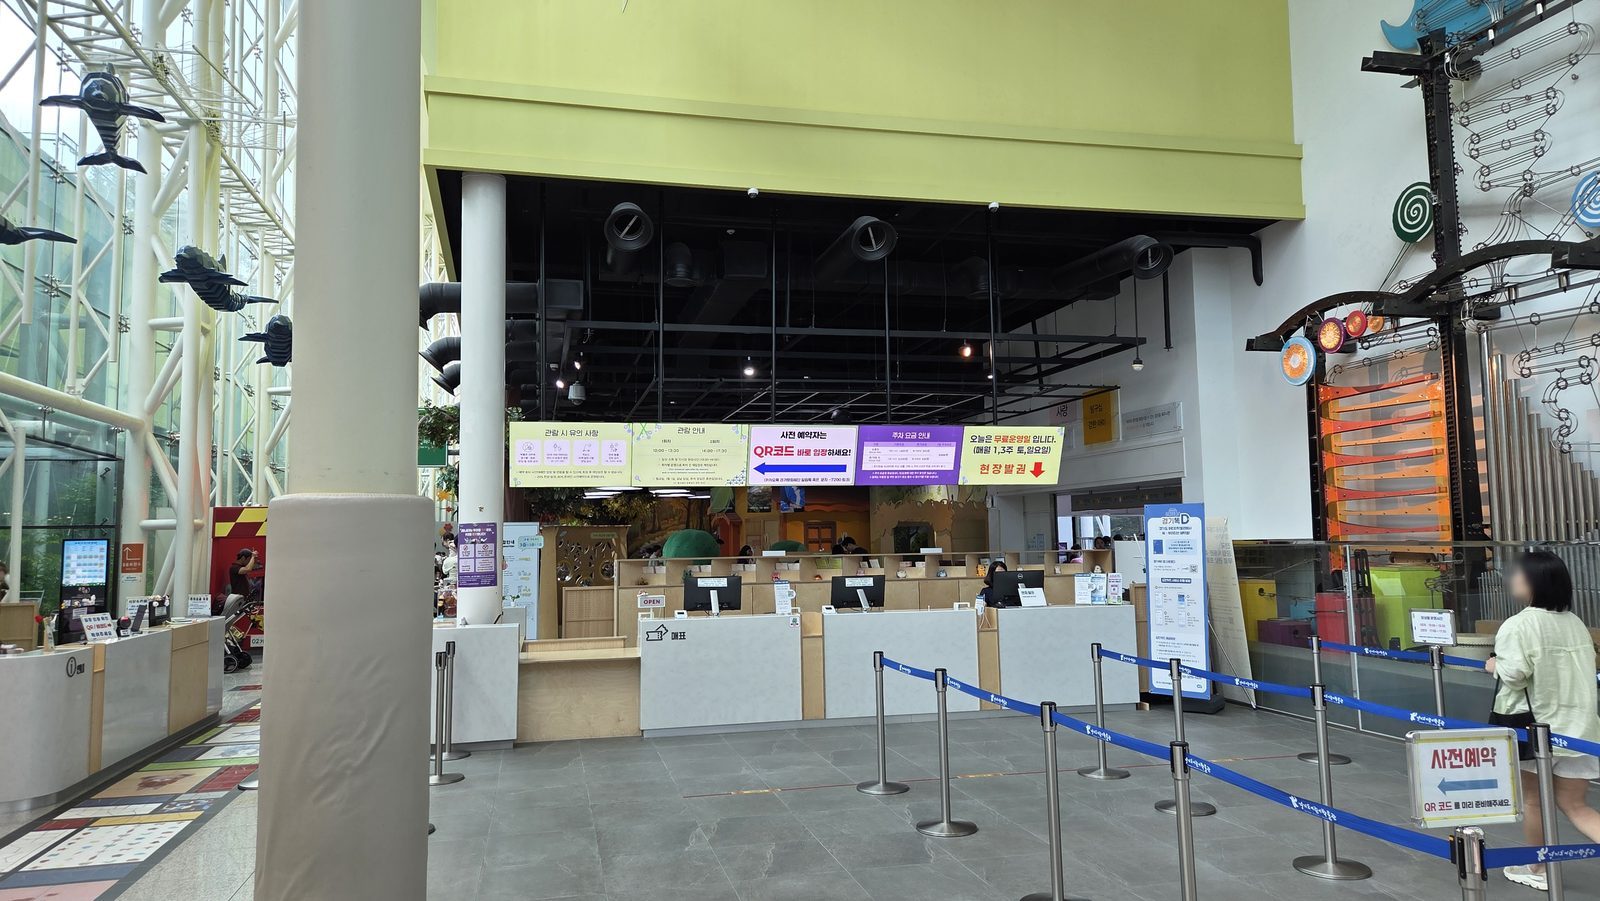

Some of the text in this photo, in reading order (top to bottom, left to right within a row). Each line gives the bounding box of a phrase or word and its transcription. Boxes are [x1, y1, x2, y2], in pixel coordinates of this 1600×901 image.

[545, 429, 599, 438] 관람 시 유의 사항
[677, 426, 691, 435] 관람
[780, 431, 828, 440] 사전 예약자는
[892, 431, 931, 440] 주차 요금 안내
[970, 434, 1057, 444] 오늘은 무료운영일 입니다.
[753, 445, 852, 458] QR코드 바로 입장하세요!
[973, 446, 1051, 455] (매월 1,3주 토,일요일)
[979, 463, 1027, 475] 현장발권
[671, 631, 687, 641] 매표
[1430, 746, 1497, 770] 사전예약
[1424, 798, 1512, 812] QR 코드 를 미리 준비해주세요.
